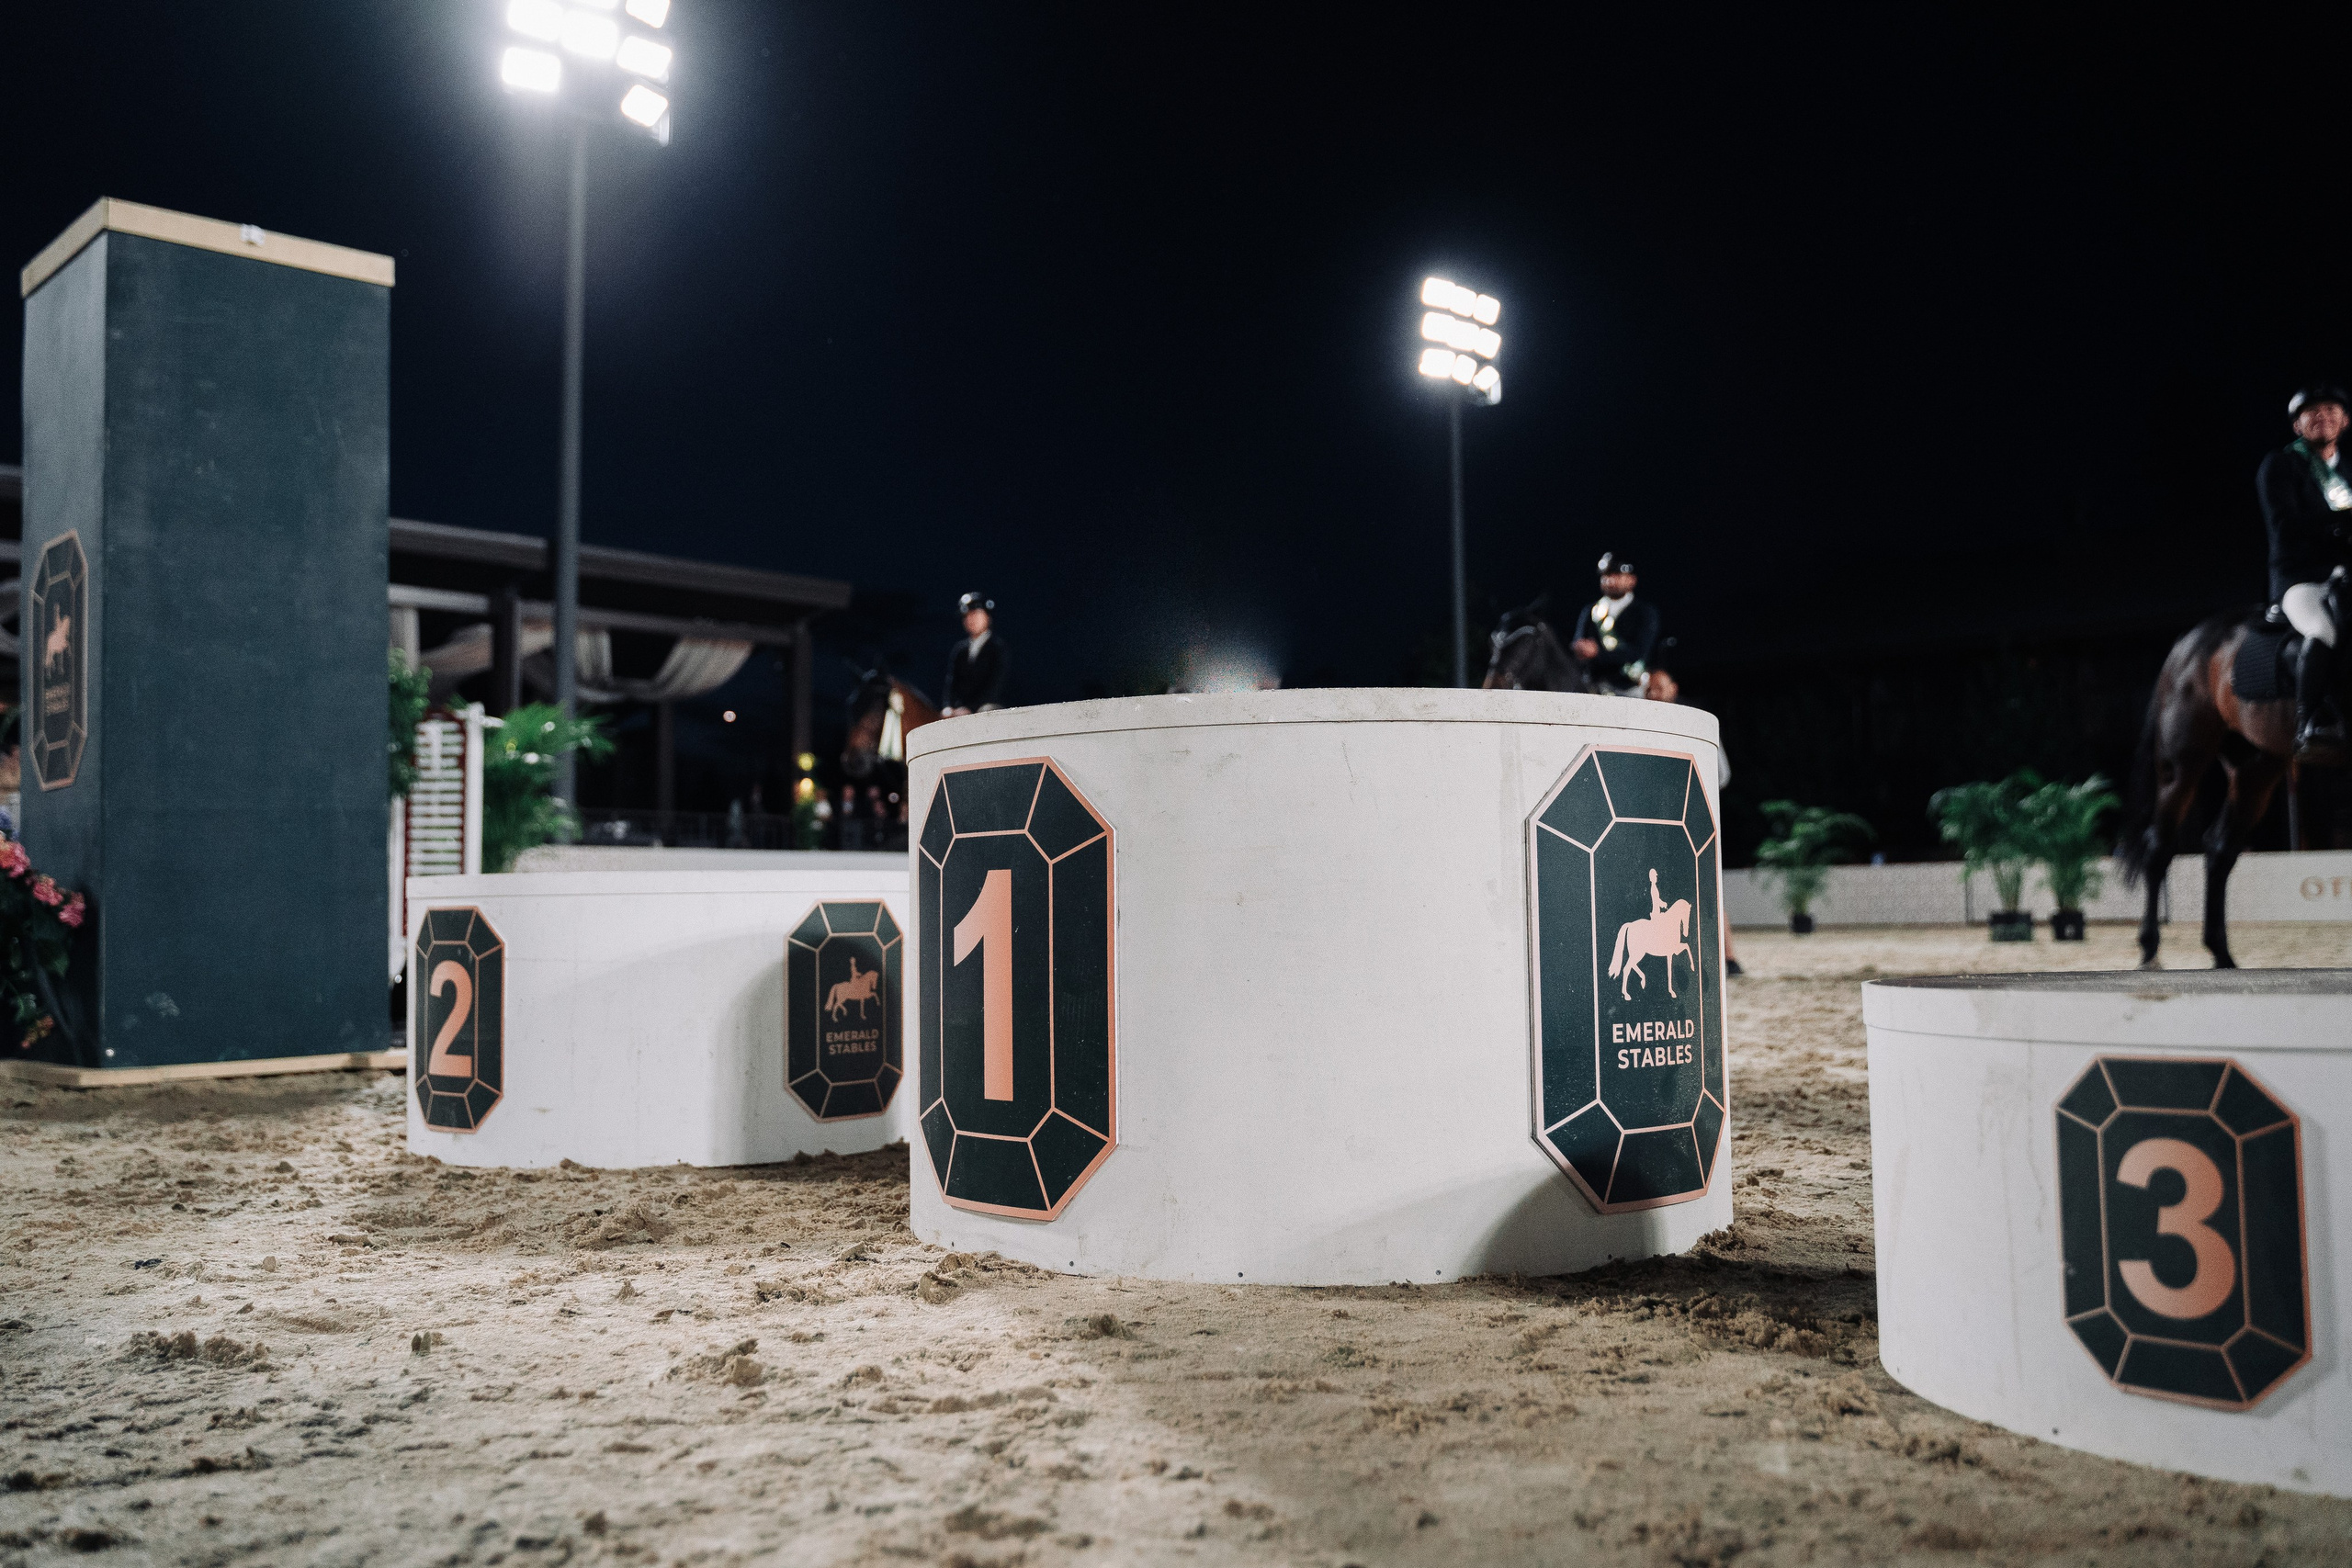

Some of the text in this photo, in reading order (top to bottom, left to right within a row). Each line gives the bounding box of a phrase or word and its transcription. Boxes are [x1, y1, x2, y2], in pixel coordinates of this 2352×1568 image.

[954, 869, 1013, 1101] 1
[428, 960, 472, 1077] 2
[1612, 1019, 1695, 1043] EMERALD
[826, 1029, 879, 1043] EMERALD
[829, 1042, 876, 1055] STABLES
[1617, 1044, 1692, 1069] STABLES
[2116, 1137, 2235, 1320] 3
